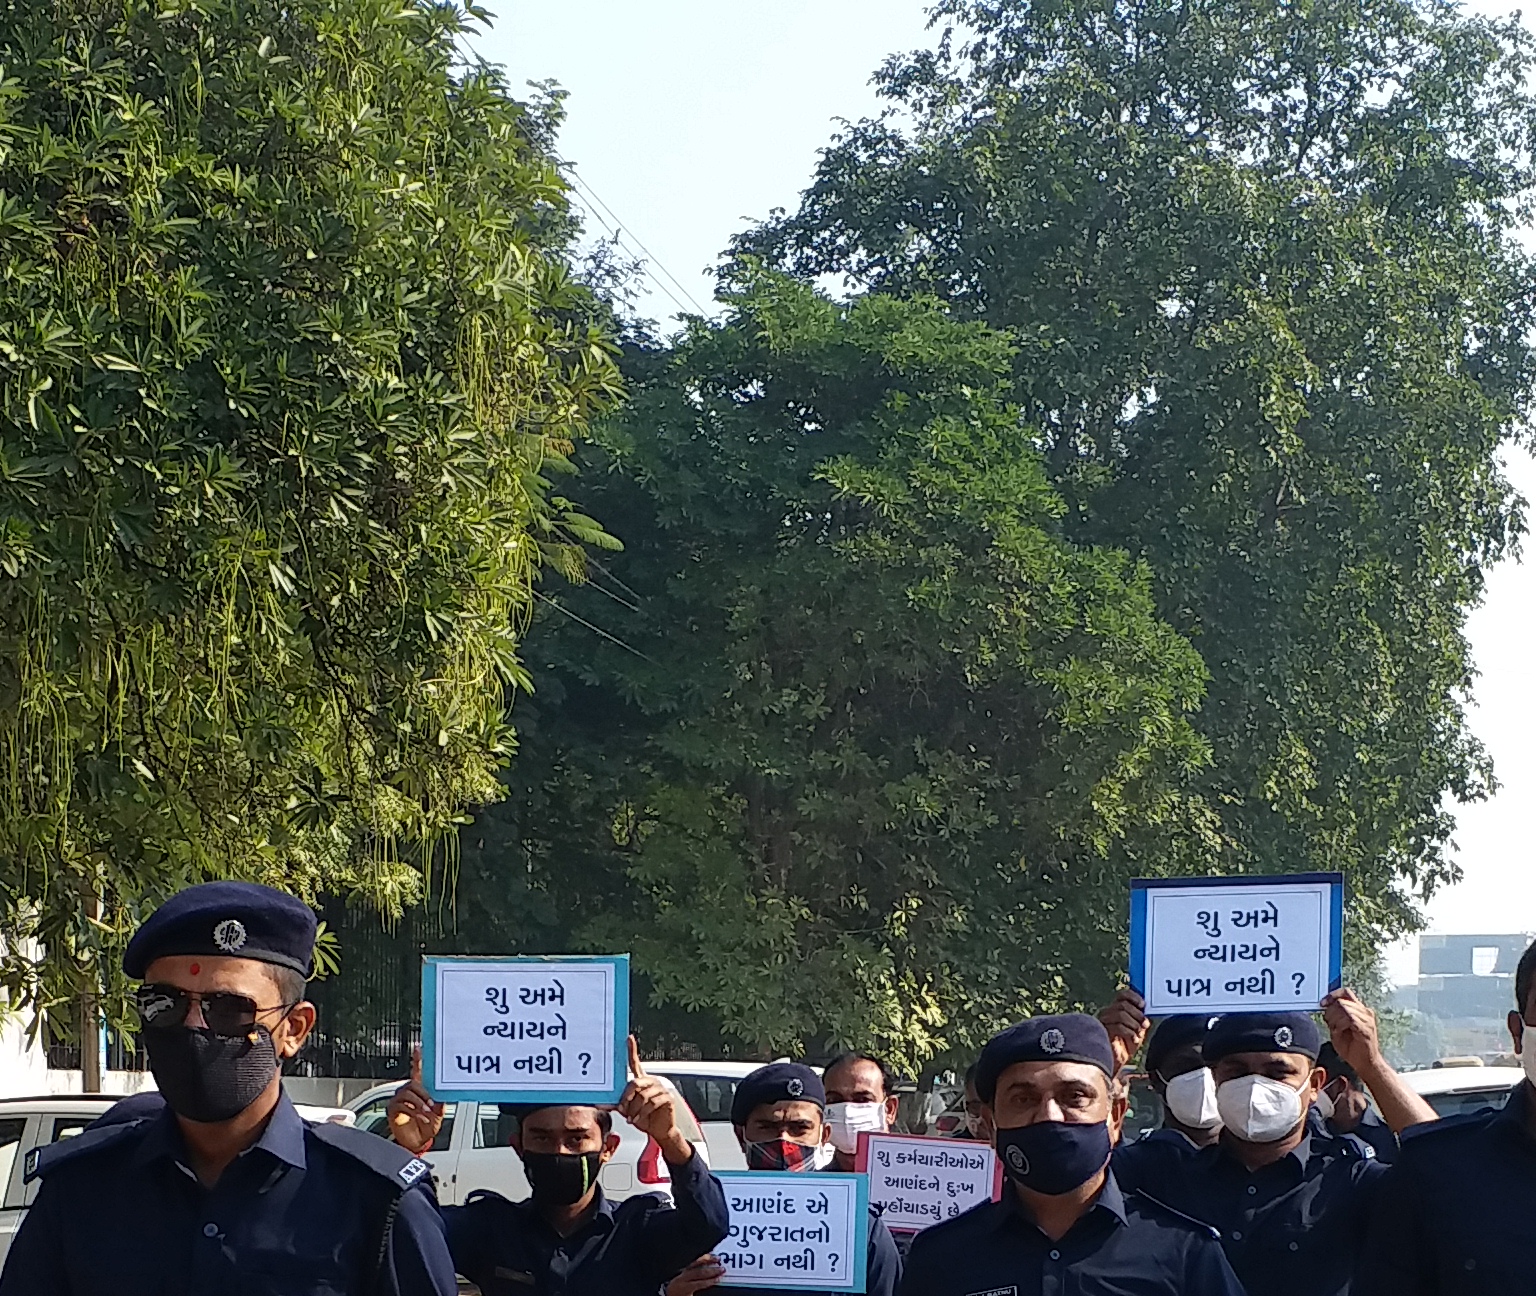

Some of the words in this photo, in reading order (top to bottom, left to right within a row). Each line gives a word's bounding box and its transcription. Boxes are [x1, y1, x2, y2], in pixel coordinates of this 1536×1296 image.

[1196, 910, 1222, 937] શુ
[1230, 901, 1279, 928] અમે
[1193, 935, 1280, 963] ન્યાયને
[485, 987, 509, 1014] શુ
[519, 979, 565, 1006] અમે
[1166, 978, 1211, 998] પાત્ર
[1224, 968, 1275, 996] નથી
[1291, 972, 1307, 996] ?
[483, 1013, 567, 1040] ન્યાયને
[456, 1054, 501, 1074] પાત્ર
[514, 1047, 562, 1074] નથી
[578, 1053, 592, 1076] ?
[877, 1150, 891, 1168] શુ
[896, 1149, 984, 1170] કર્મચારીઓએ
[884, 1174, 940, 1192] આણંદને
[731, 1191, 796, 1214] આણંદ
[806, 1191, 828, 1215] એ
[947, 1202, 960, 1217] છે
[729, 1220, 829, 1248] ગુજરાતનો
[719, 1252, 763, 1269] ભાગ
[774, 1248, 814, 1270] નથી
[827, 1253, 840, 1272] ?
